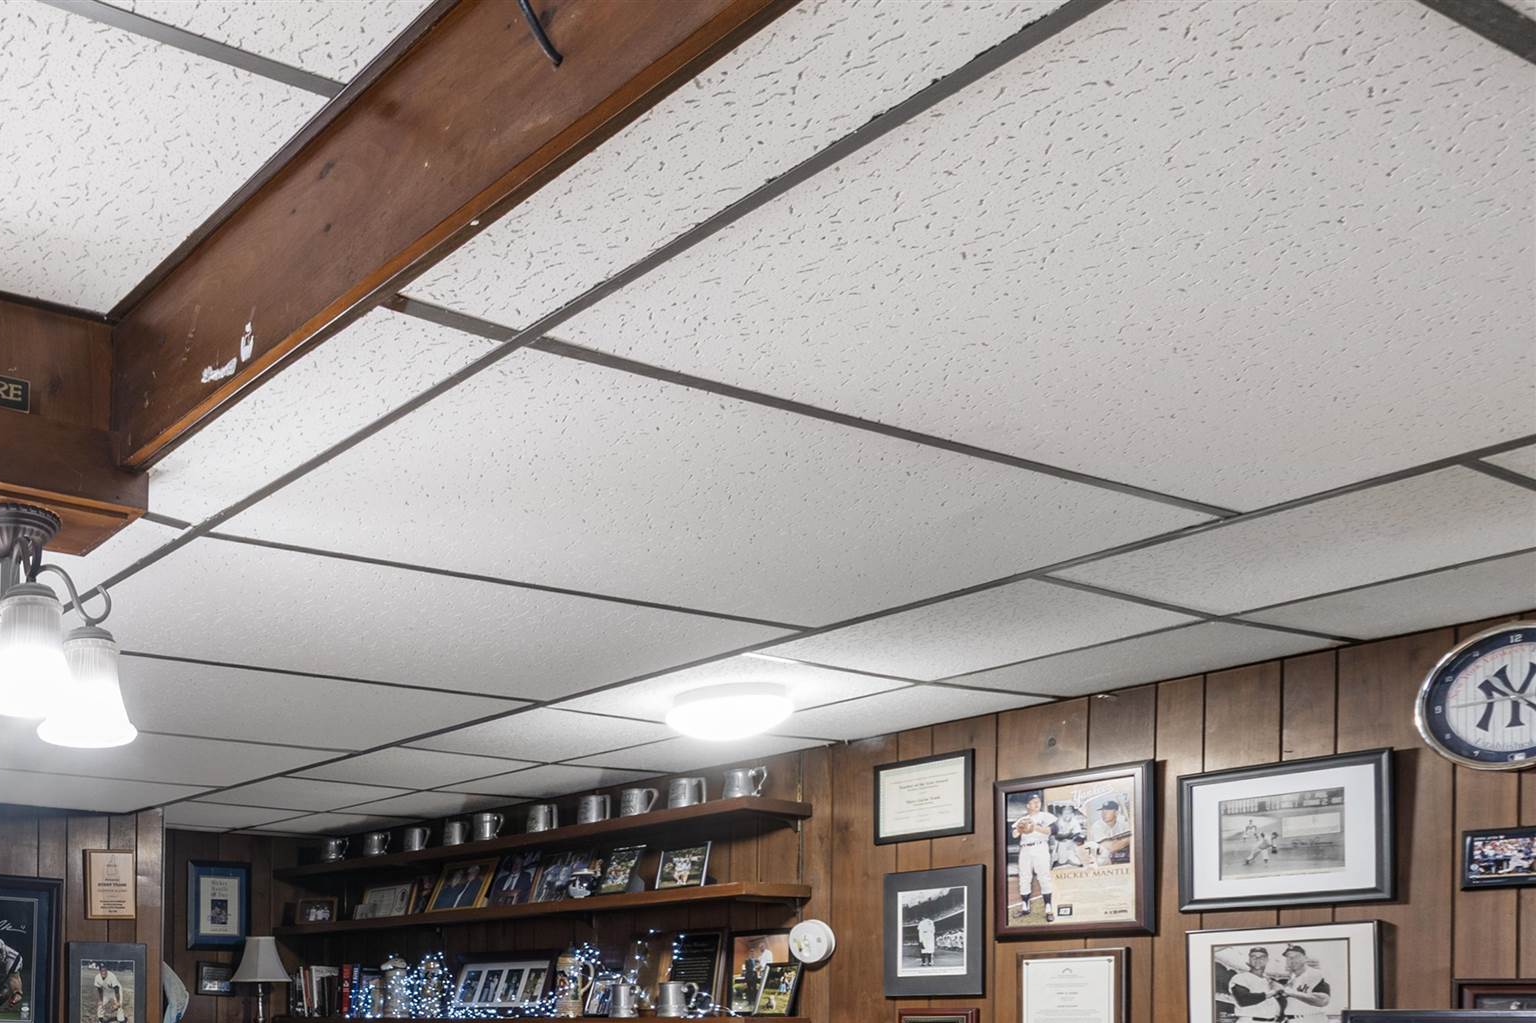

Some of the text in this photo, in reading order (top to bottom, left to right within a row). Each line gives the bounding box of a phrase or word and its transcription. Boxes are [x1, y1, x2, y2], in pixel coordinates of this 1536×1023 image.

[1509, 633, 1523, 644] 12
[1054, 867, 1130, 881] MICKEY MANTLE
